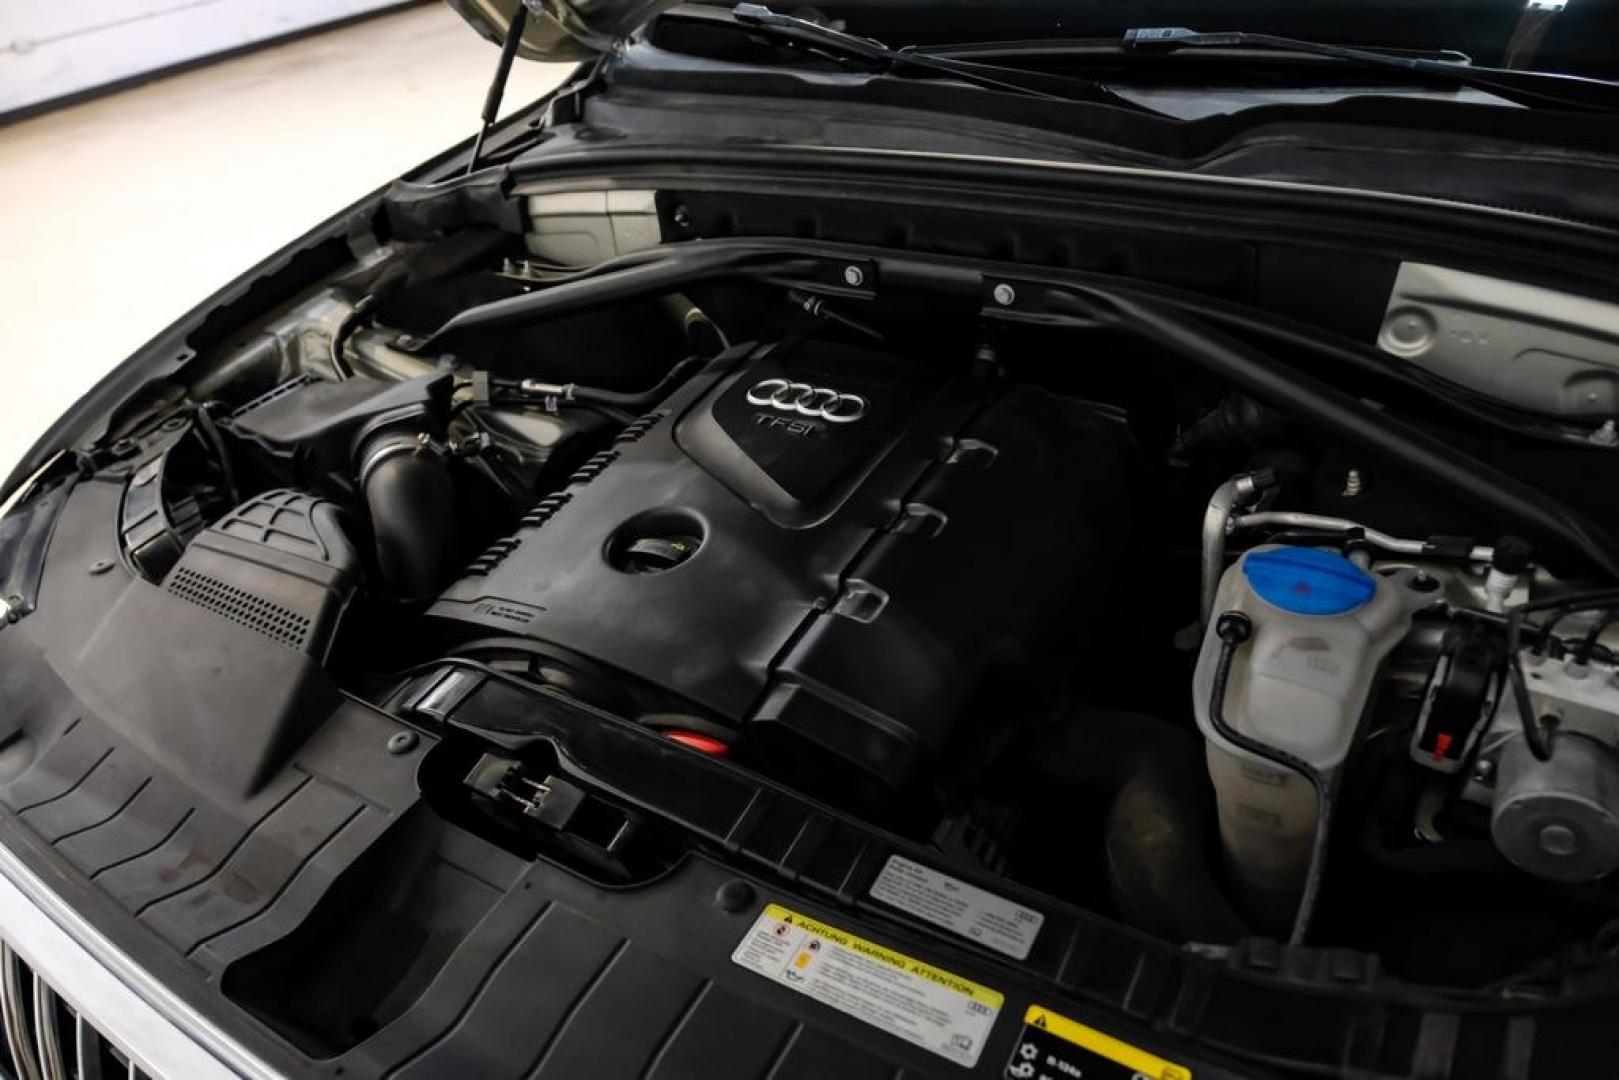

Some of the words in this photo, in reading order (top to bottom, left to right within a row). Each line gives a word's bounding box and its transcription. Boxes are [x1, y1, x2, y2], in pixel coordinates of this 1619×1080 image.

[756, 413, 813, 437] TFSI
[799, 920, 847, 946] ACHTUNG
[853, 943, 906, 970] WARNING
[911, 966, 974, 996] ATTENTION
